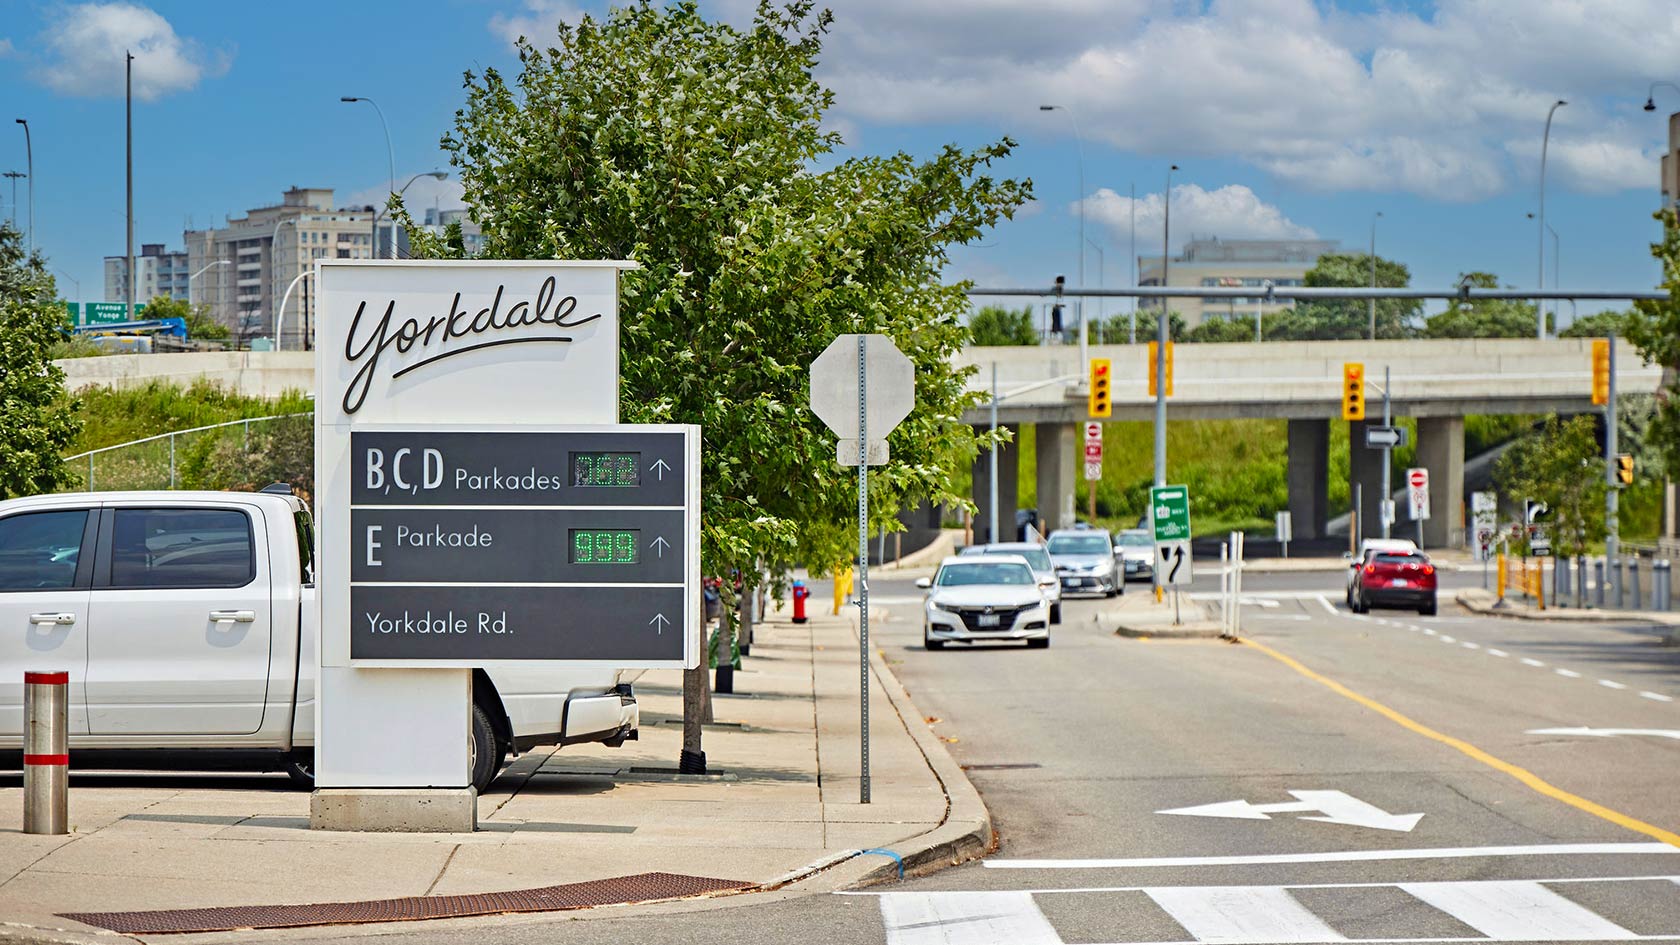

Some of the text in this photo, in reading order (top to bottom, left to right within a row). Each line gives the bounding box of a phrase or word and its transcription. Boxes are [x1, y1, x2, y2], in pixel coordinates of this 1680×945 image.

[97, 312, 120, 320] Yonge
[343, 276, 601, 415] Yorkdale
[366, 447, 561, 495] B,C,D Parkades
[576, 456, 633, 486] 762
[366, 524, 493, 566] E Parkade
[575, 532, 634, 563] 999
[366, 611, 514, 635] Yorkdale Rd.
